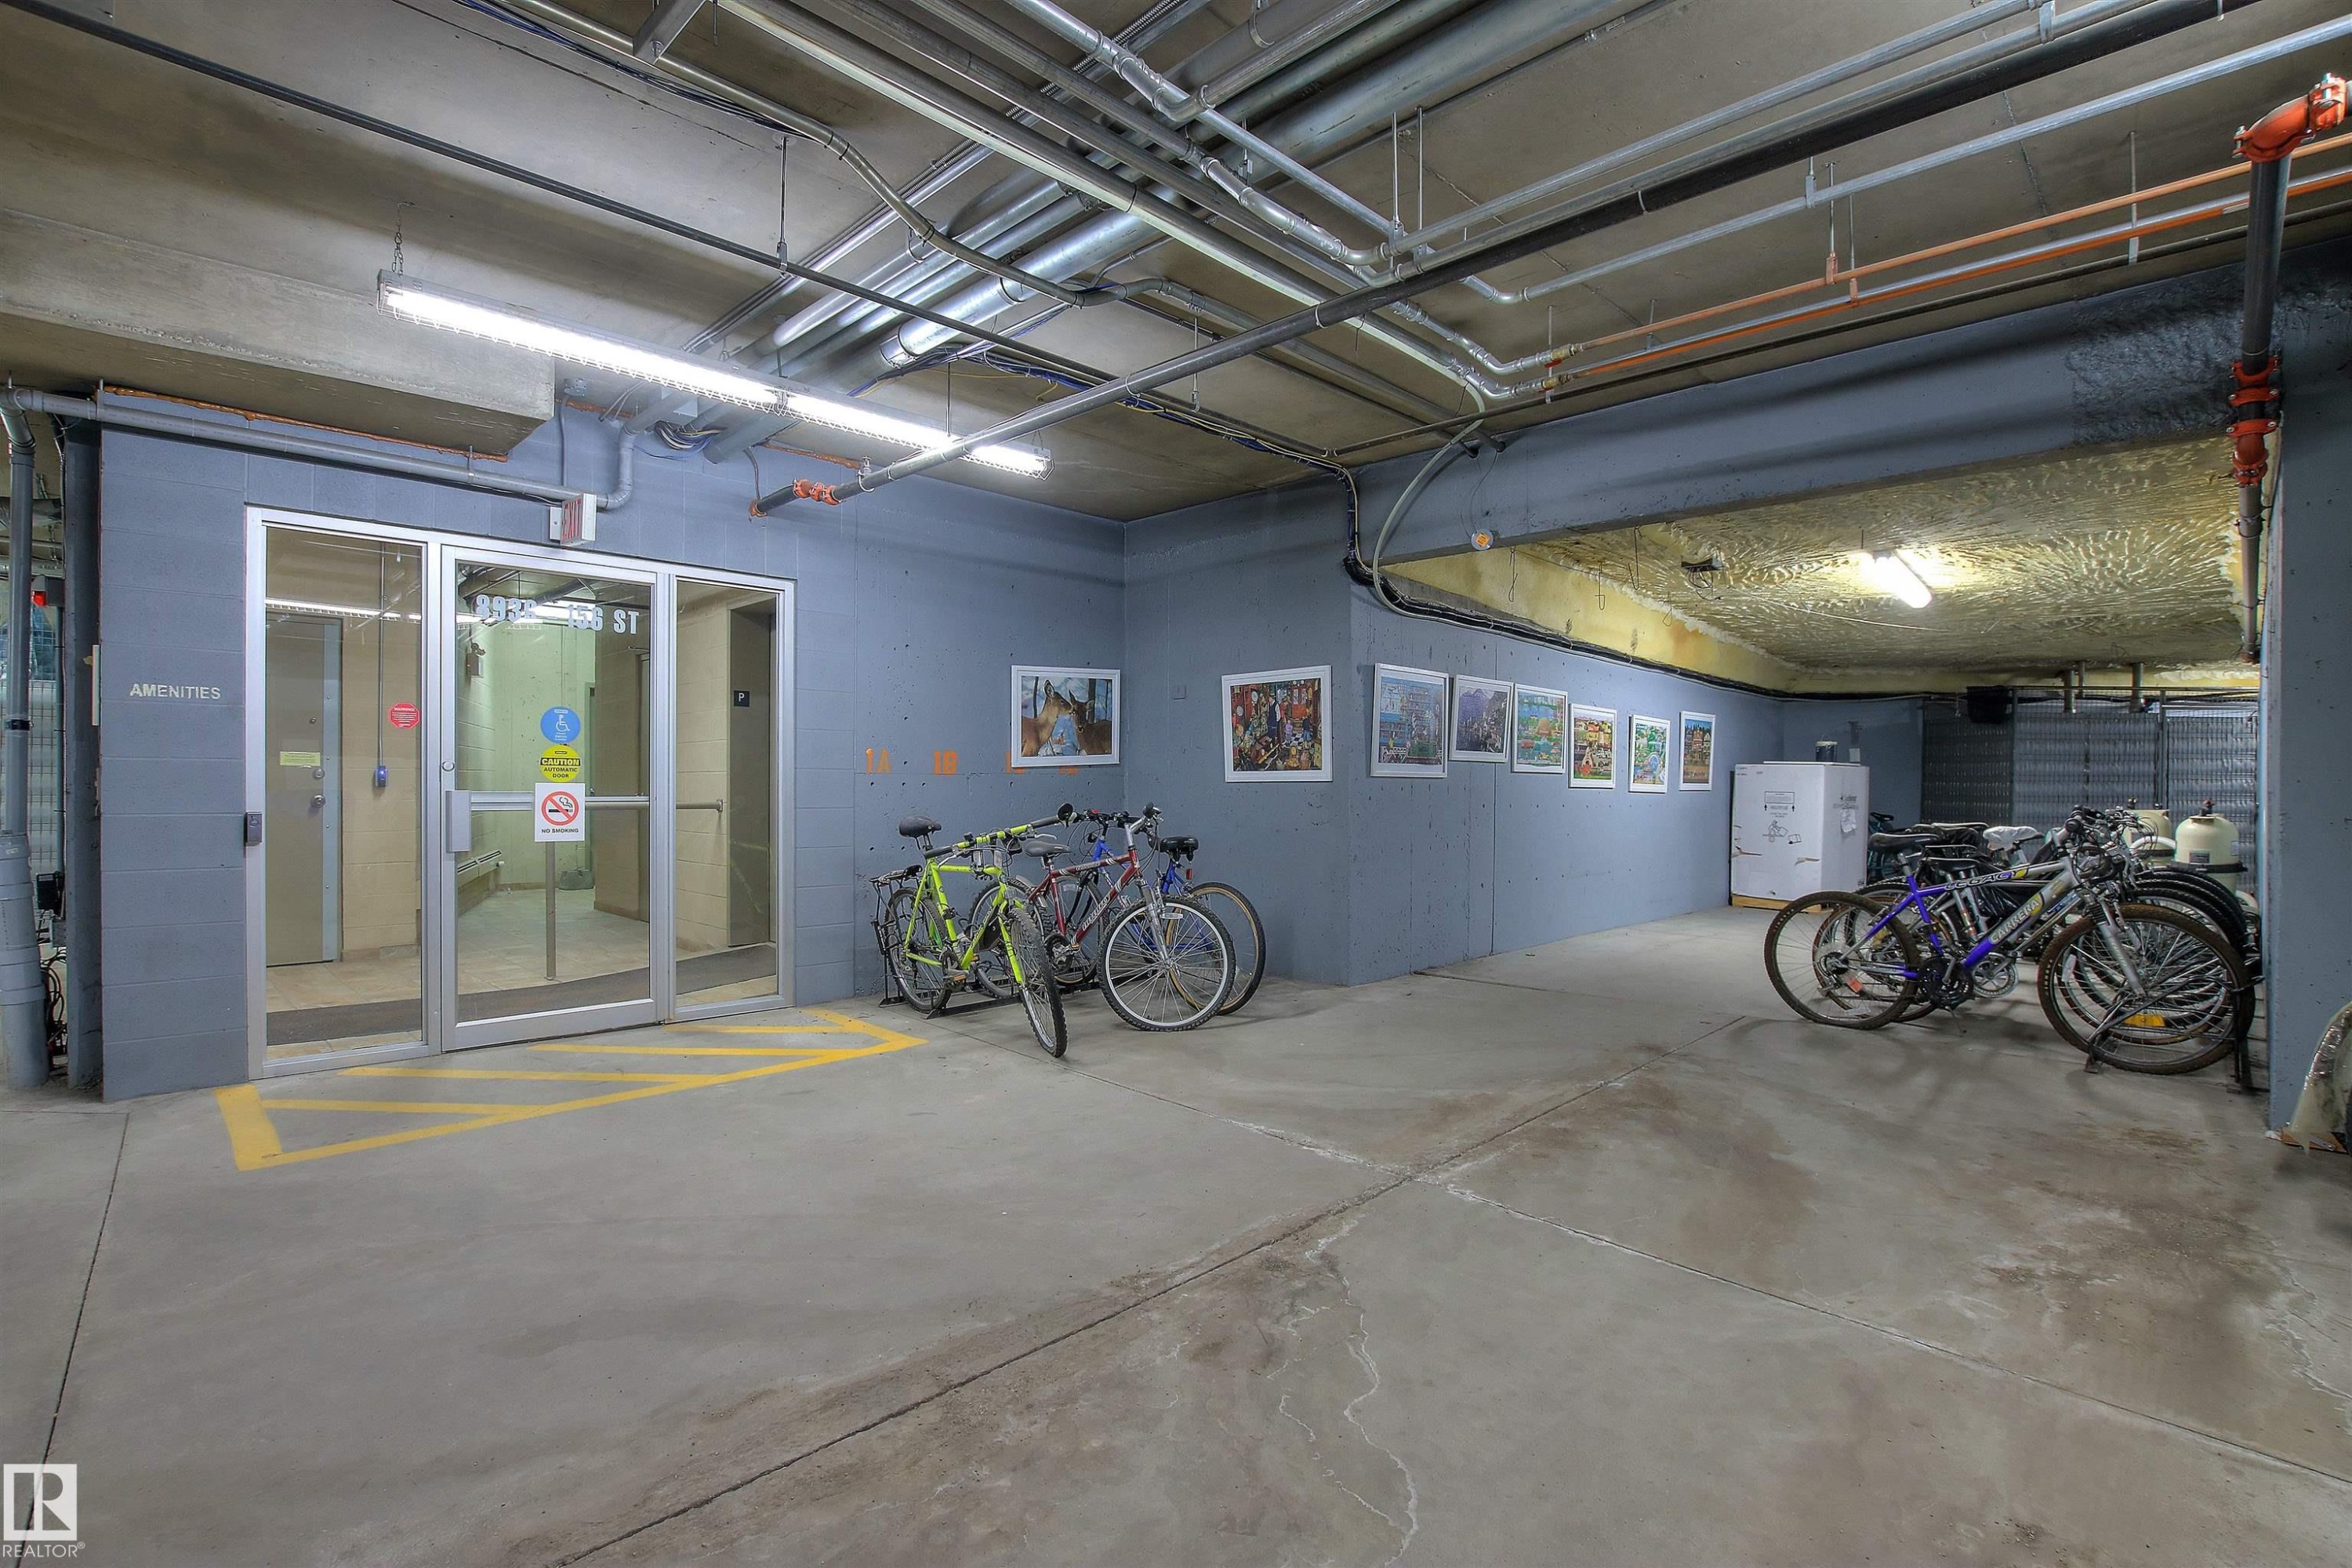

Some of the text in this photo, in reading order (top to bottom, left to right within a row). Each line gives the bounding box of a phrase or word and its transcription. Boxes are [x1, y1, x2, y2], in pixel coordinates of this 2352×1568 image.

[566, 604, 604, 631] 156
[613, 609, 639, 634] ST
[129, 684, 221, 699] AMENITIES
[739, 692, 745, 702] P
[865, 748, 891, 774] 1A
[934, 750, 958, 775] 1B
[1944, 870, 2016, 891] LEGACY
[1989, 898, 2041, 945] CARRERA
